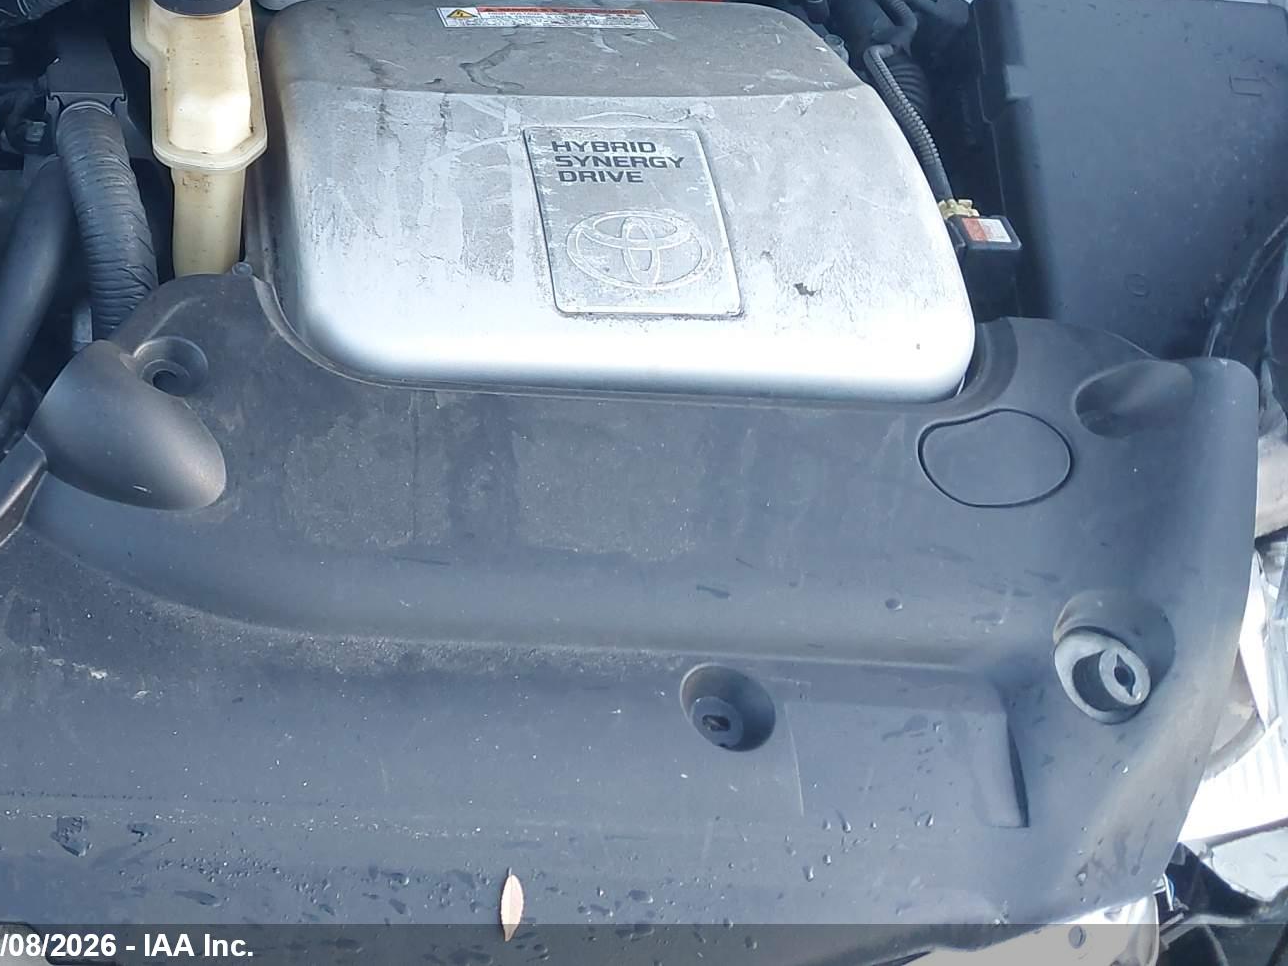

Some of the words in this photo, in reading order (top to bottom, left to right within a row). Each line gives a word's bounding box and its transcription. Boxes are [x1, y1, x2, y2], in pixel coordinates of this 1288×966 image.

[552, 141, 656, 153] HYBRID
[556, 156, 685, 169] SYNERGY
[559, 170, 644, 183] DRIVE
